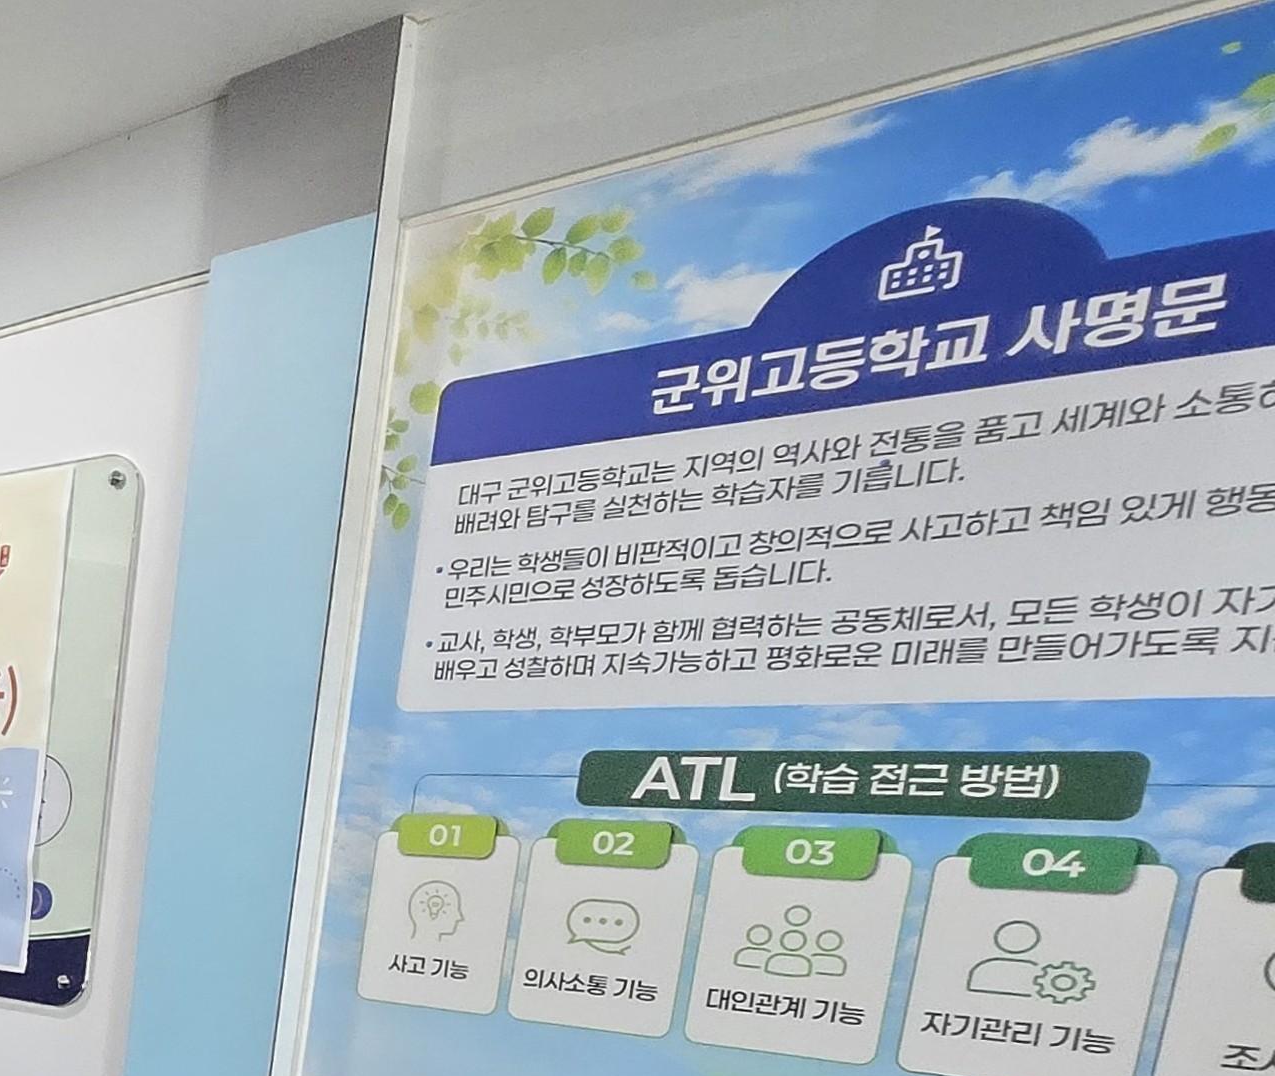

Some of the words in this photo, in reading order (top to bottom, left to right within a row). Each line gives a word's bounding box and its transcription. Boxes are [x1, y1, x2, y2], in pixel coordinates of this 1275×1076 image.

[651, 317, 988, 416] 군위고등학교
[1004, 272, 1230, 358] 사명문
[458, 480, 501, 506] 대구
[508, 460, 676, 500] 군위고등학교는
[682, 446, 764, 479] 지역의
[773, 434, 861, 466] 역사와
[869, 421, 965, 458] 전통을
[974, 411, 1044, 445] 품고
[1051, 393, 1166, 434] 세계와
[454, 507, 520, 535] 배려와
[526, 499, 597, 528] 탐구를
[603, 489, 703, 521] 실천하는
[711, 472, 824, 506] 학습자를
[832, 457, 965, 494] 기릅니다.
[448, 555, 512, 582] 우리는
[517, 545, 609, 574] 학생들이
[614, 533, 741, 568] 비판적이고
[748, 518, 893, 556] 창의적으로
[898, 506, 1032, 544] 사고하고
[1040, 497, 1111, 529] 책임
[1120, 489, 1197, 524] 있게
[444, 577, 574, 609] 민주시민으로
[580, 567, 706, 601] 성장하도록
[713, 559, 833, 591] 돕습니다.
[437, 629, 486, 654] 교사,
[492, 626, 542, 651] 학생,
[549, 619, 646, 648] 학부모가
[652, 618, 704, 644] 함께
[711, 611, 823, 640] 협력하는
[830, 602, 997, 636] 공동체로서,
[1006, 595, 1078, 627] 모든
[1089, 588, 1205, 622] 학생이
[433, 659, 497, 681] 배우고
[504, 654, 595, 679] 성찰하며
[602, 648, 757, 676] 지속가능하고
[766, 641, 882, 671] 평화로운
[891, 637, 988, 667] 미래를
[997, 627, 1219, 663] 만들어가도록
[631, 756, 755, 802] ATL
[774, 762, 859, 794] (학습
[870, 764, 949, 797] 접근
[960, 763, 1059, 799] 방법)
[428, 824, 462, 847] 01
[592, 832, 635, 856] 02
[784, 839, 835, 865] 03
[1022, 849, 1086, 878] 04
[388, 953, 426, 976] 사고
[431, 957, 469, 980] 기능
[523, 969, 609, 997] 의사소통
[614, 977, 658, 1001] 기능
[706, 987, 806, 1019] 대인관계
[811, 998, 866, 1027] 기능
[921, 1011, 1042, 1047] 자기관리
[1049, 1025, 1116, 1055] 기능
